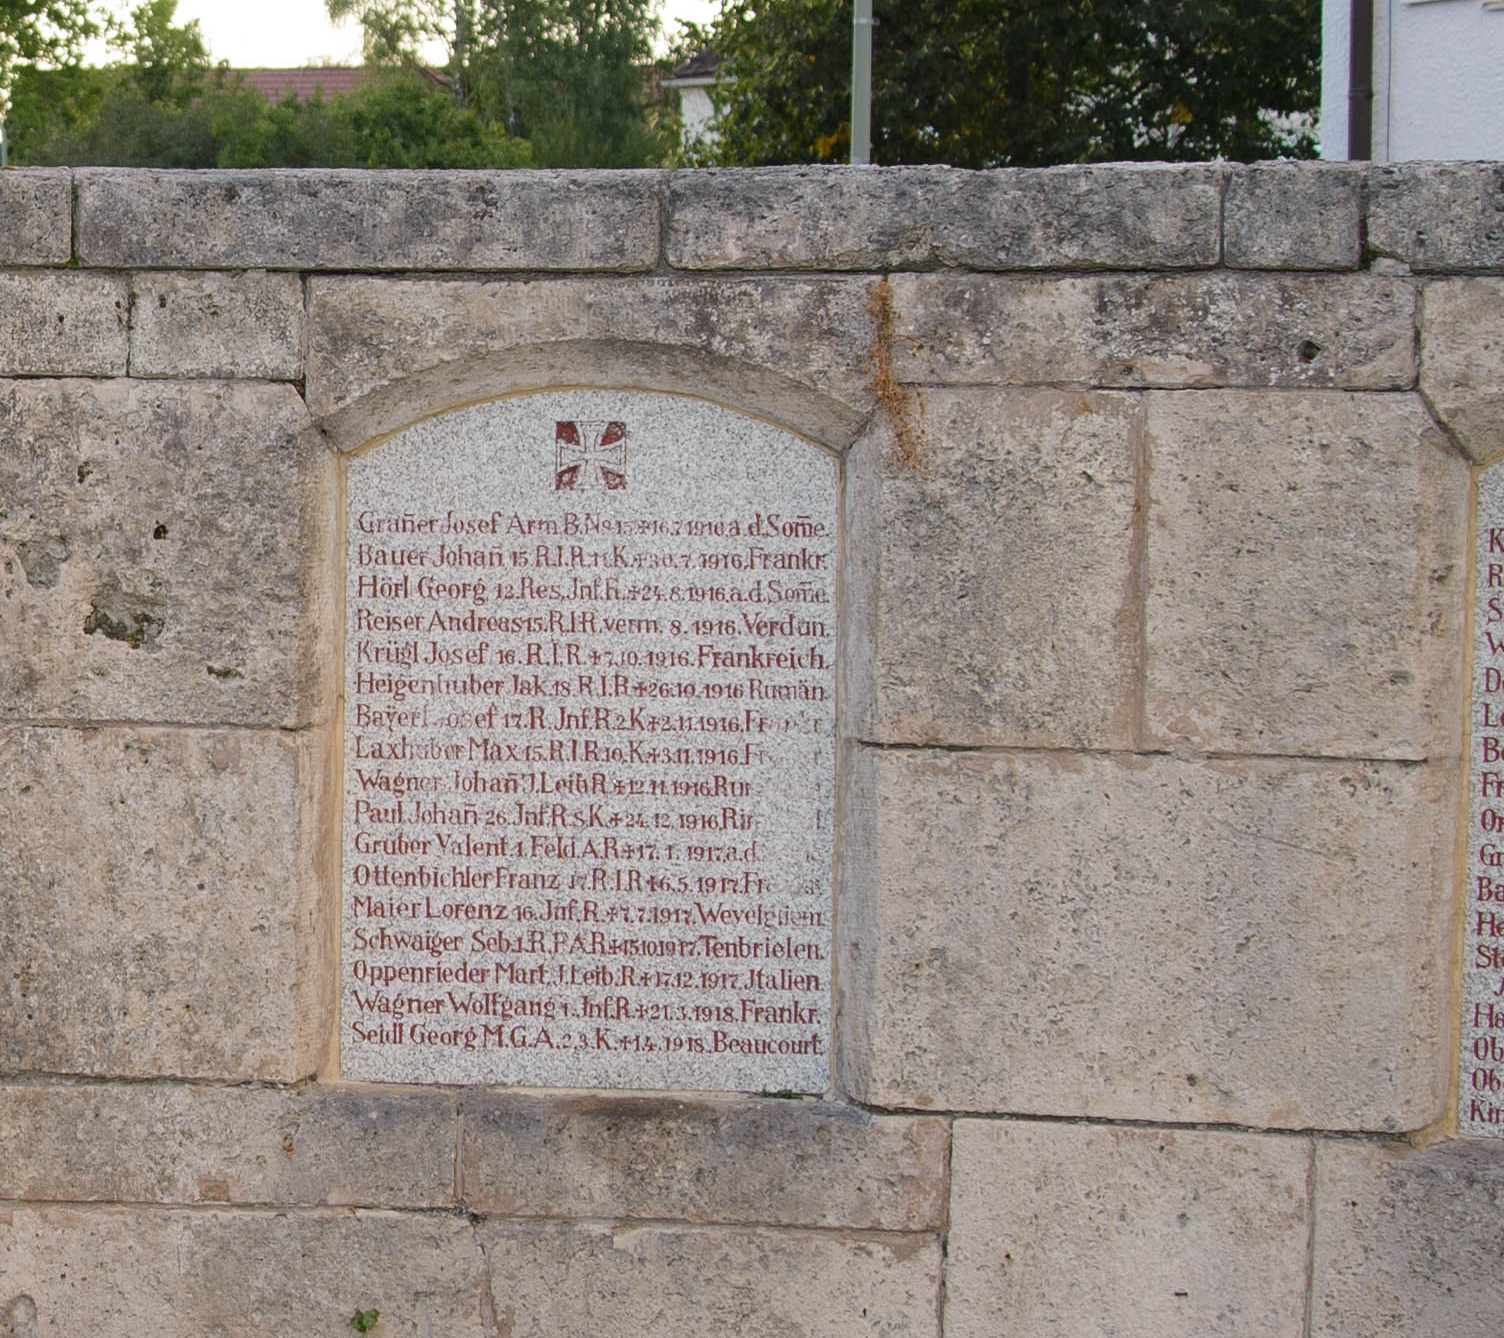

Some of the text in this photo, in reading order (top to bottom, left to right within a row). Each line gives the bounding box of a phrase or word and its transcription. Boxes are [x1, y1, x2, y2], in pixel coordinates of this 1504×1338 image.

[443, 510, 502, 534] Josef
[359, 544, 431, 567] Bauer
[357, 575, 409, 598] Hörl
[417, 576, 486, 606] Georg
[357, 609, 424, 631] Reiser
[427, 610, 522, 633] Andreas
[424, 640, 489, 664] Josef
[468, 737, 520, 761] Max
[355, 769, 442, 797] Wagner
[355, 799, 402, 825] Paul
[355, 832, 432, 854] Gruber
[353, 863, 494, 889] Ottenbichler
[496, 867, 560, 889] Franz
[353, 895, 423, 918] Maier
[424, 896, 509, 921] Lorenz
[353, 927, 464, 957] Schwaiger
[353, 959, 490, 986] Oppenrieder
[353, 989, 444, 1020] Wagner
[446, 990, 556, 1021] Wolfgang
[351, 1020, 404, 1045] Seidl
[410, 1022, 476, 1051] Georg
